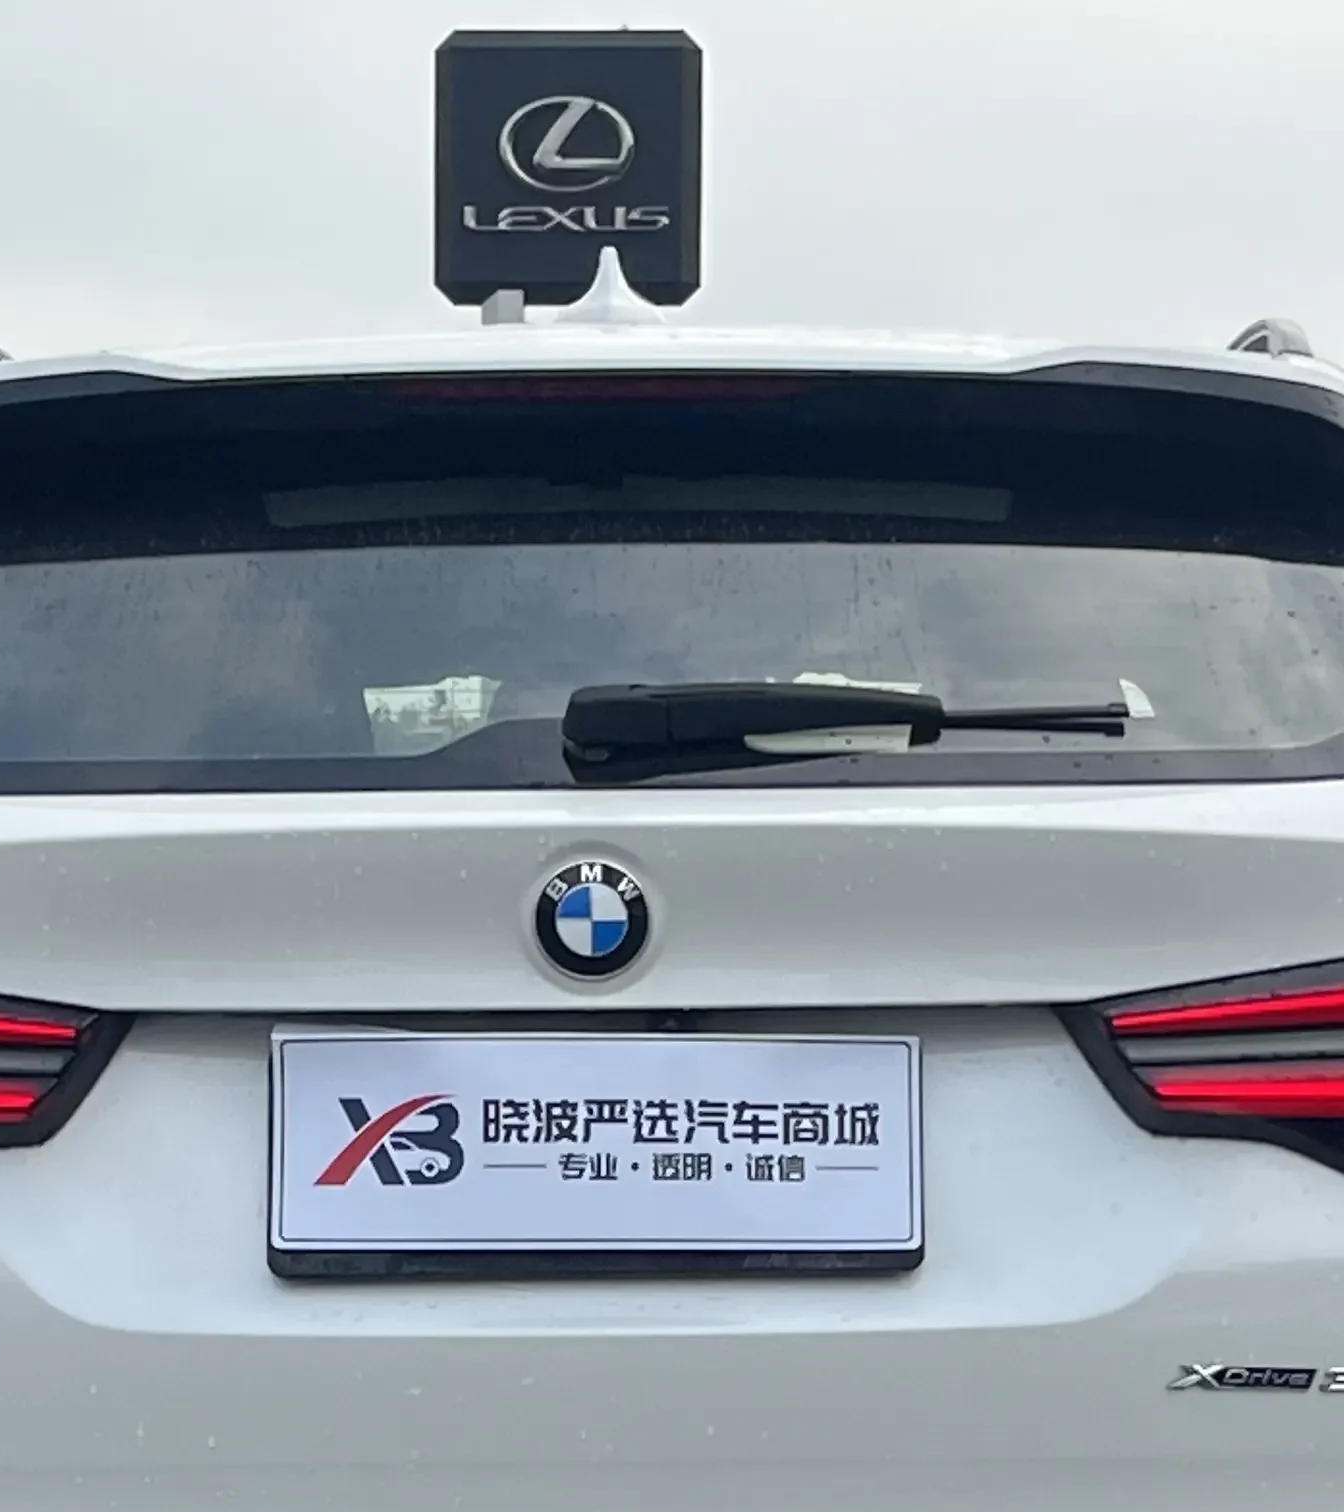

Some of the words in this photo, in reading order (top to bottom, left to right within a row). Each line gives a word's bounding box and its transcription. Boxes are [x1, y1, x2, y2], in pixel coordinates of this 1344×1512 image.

[462, 205, 670, 232] LEXUS
[545, 863, 641, 901] BMW
[482, 1098, 880, 1146] 晓波严选汽车商城
